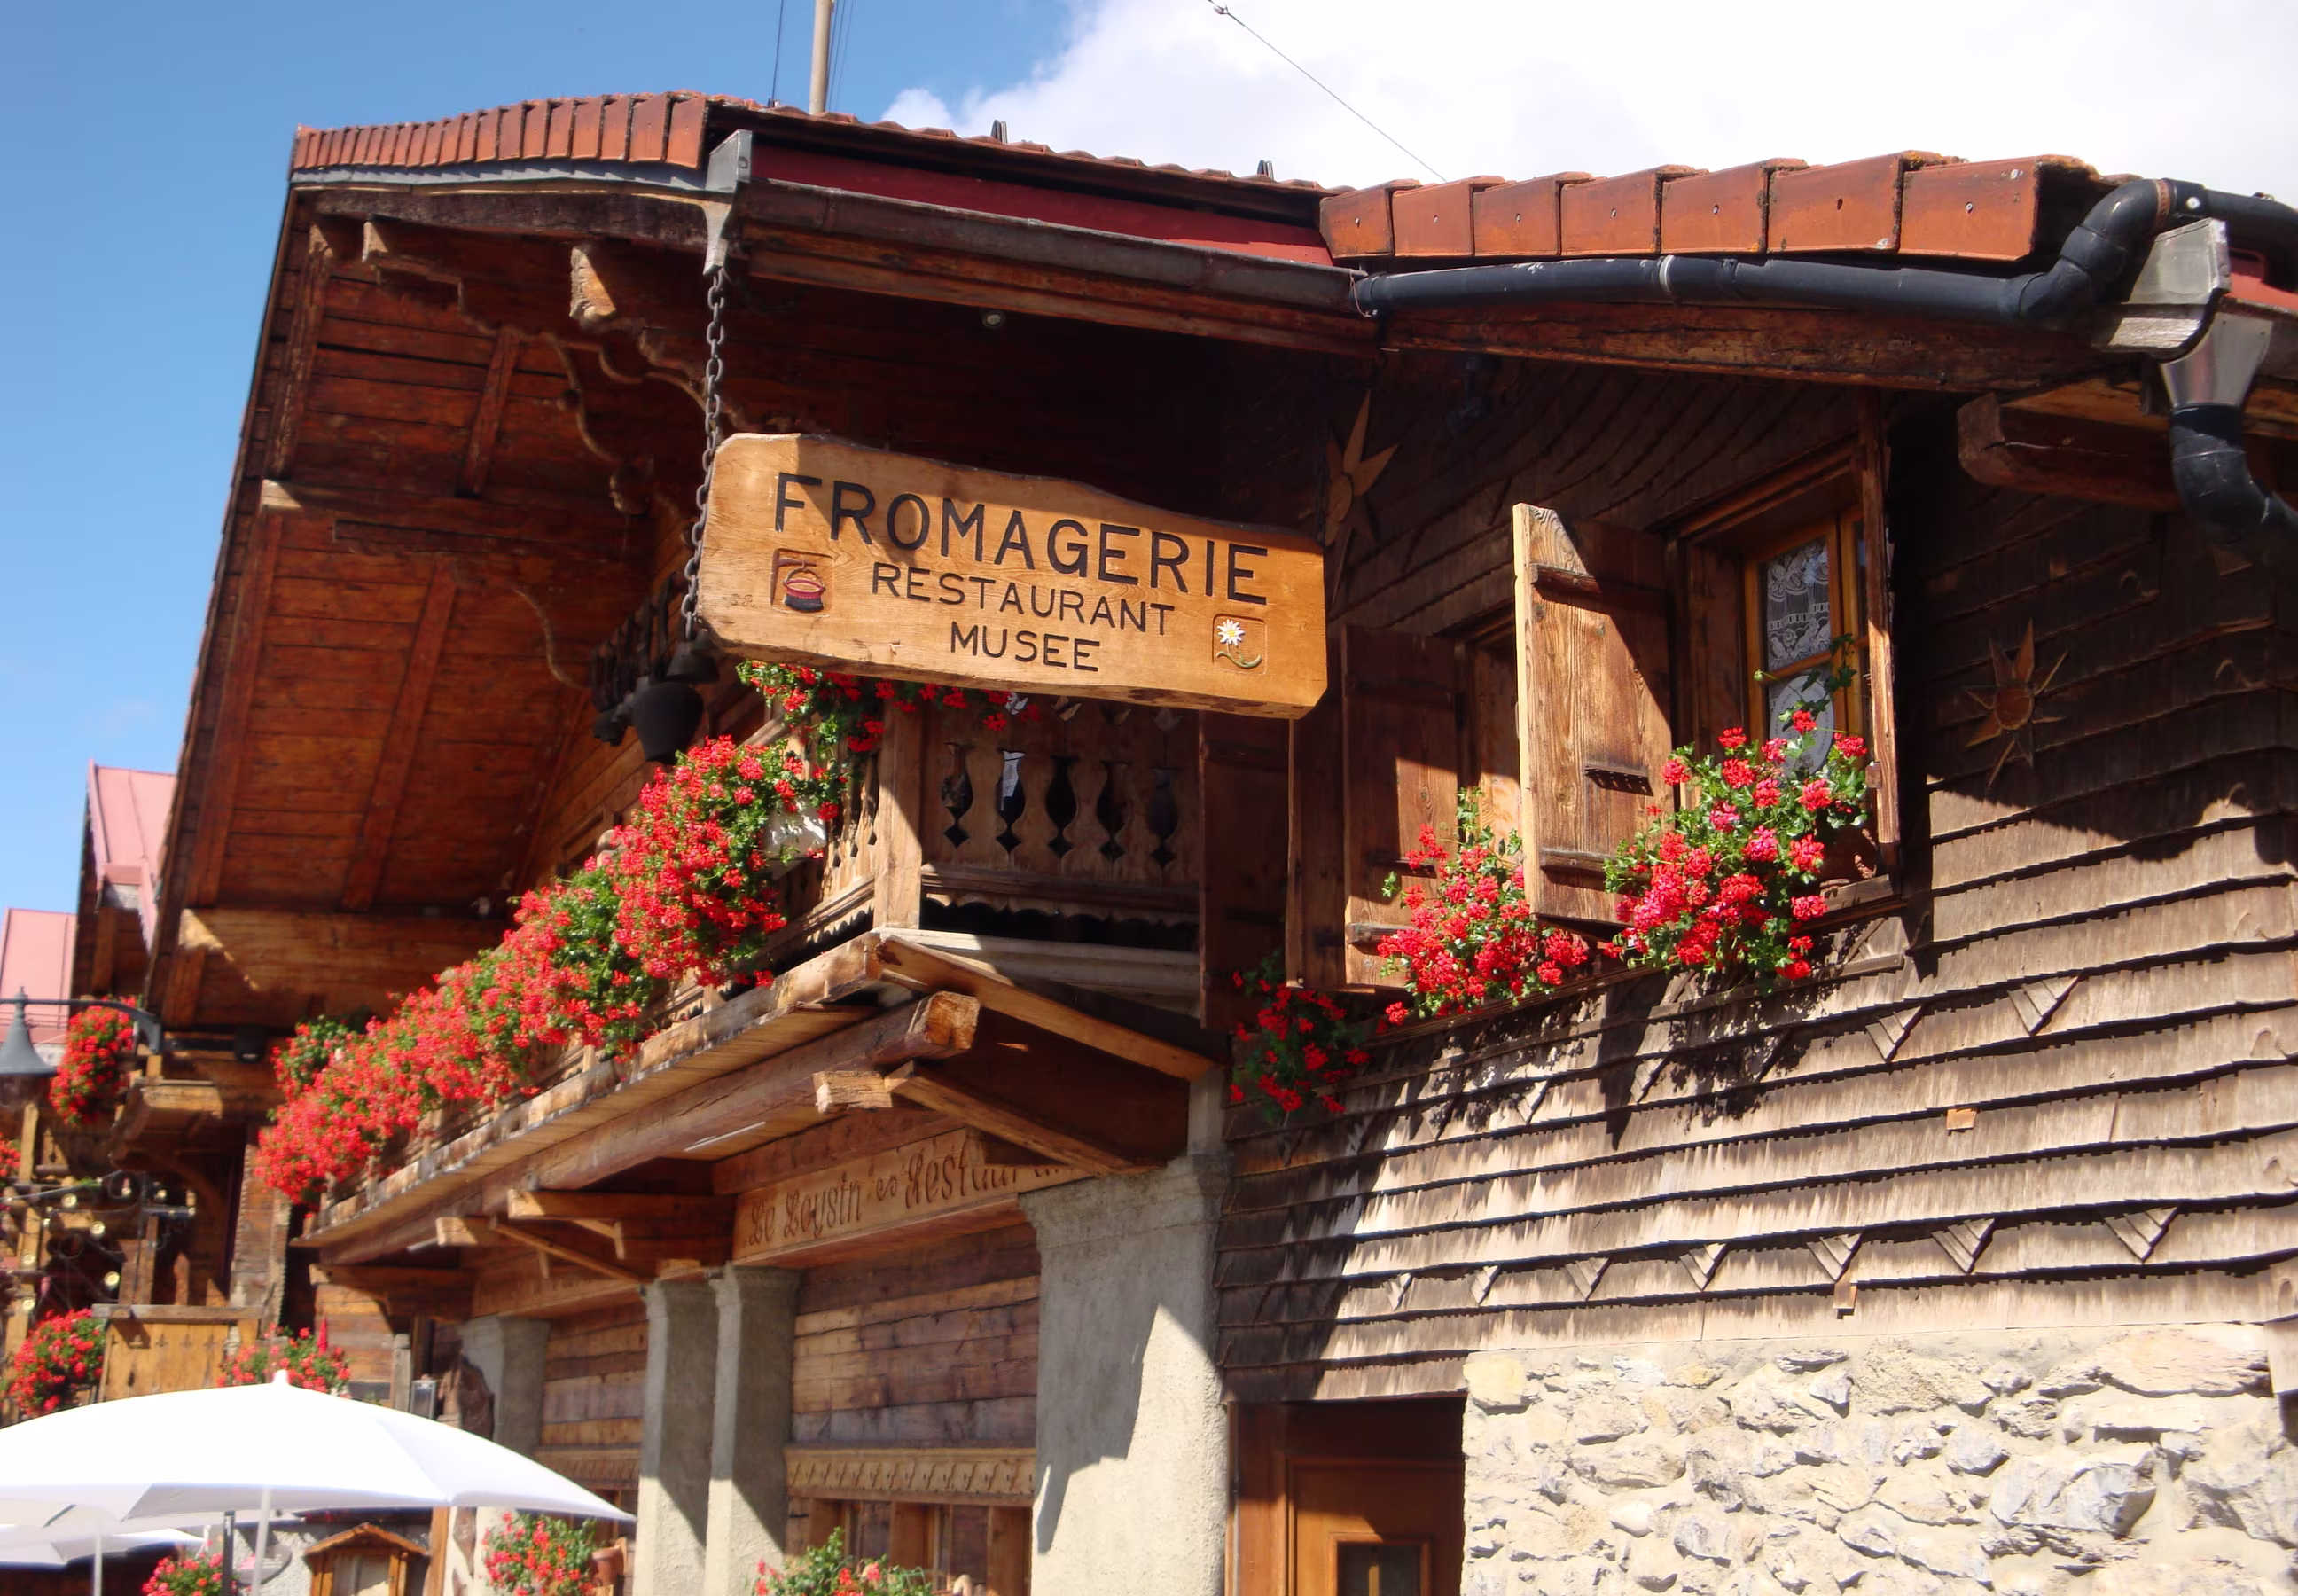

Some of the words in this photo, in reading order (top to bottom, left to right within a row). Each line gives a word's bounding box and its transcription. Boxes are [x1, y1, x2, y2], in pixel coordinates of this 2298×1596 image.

[774, 471, 1270, 606] FROMAGERIE
[872, 560, 1176, 636] RESTAURANT
[950, 621, 1100, 672] MUSEE
